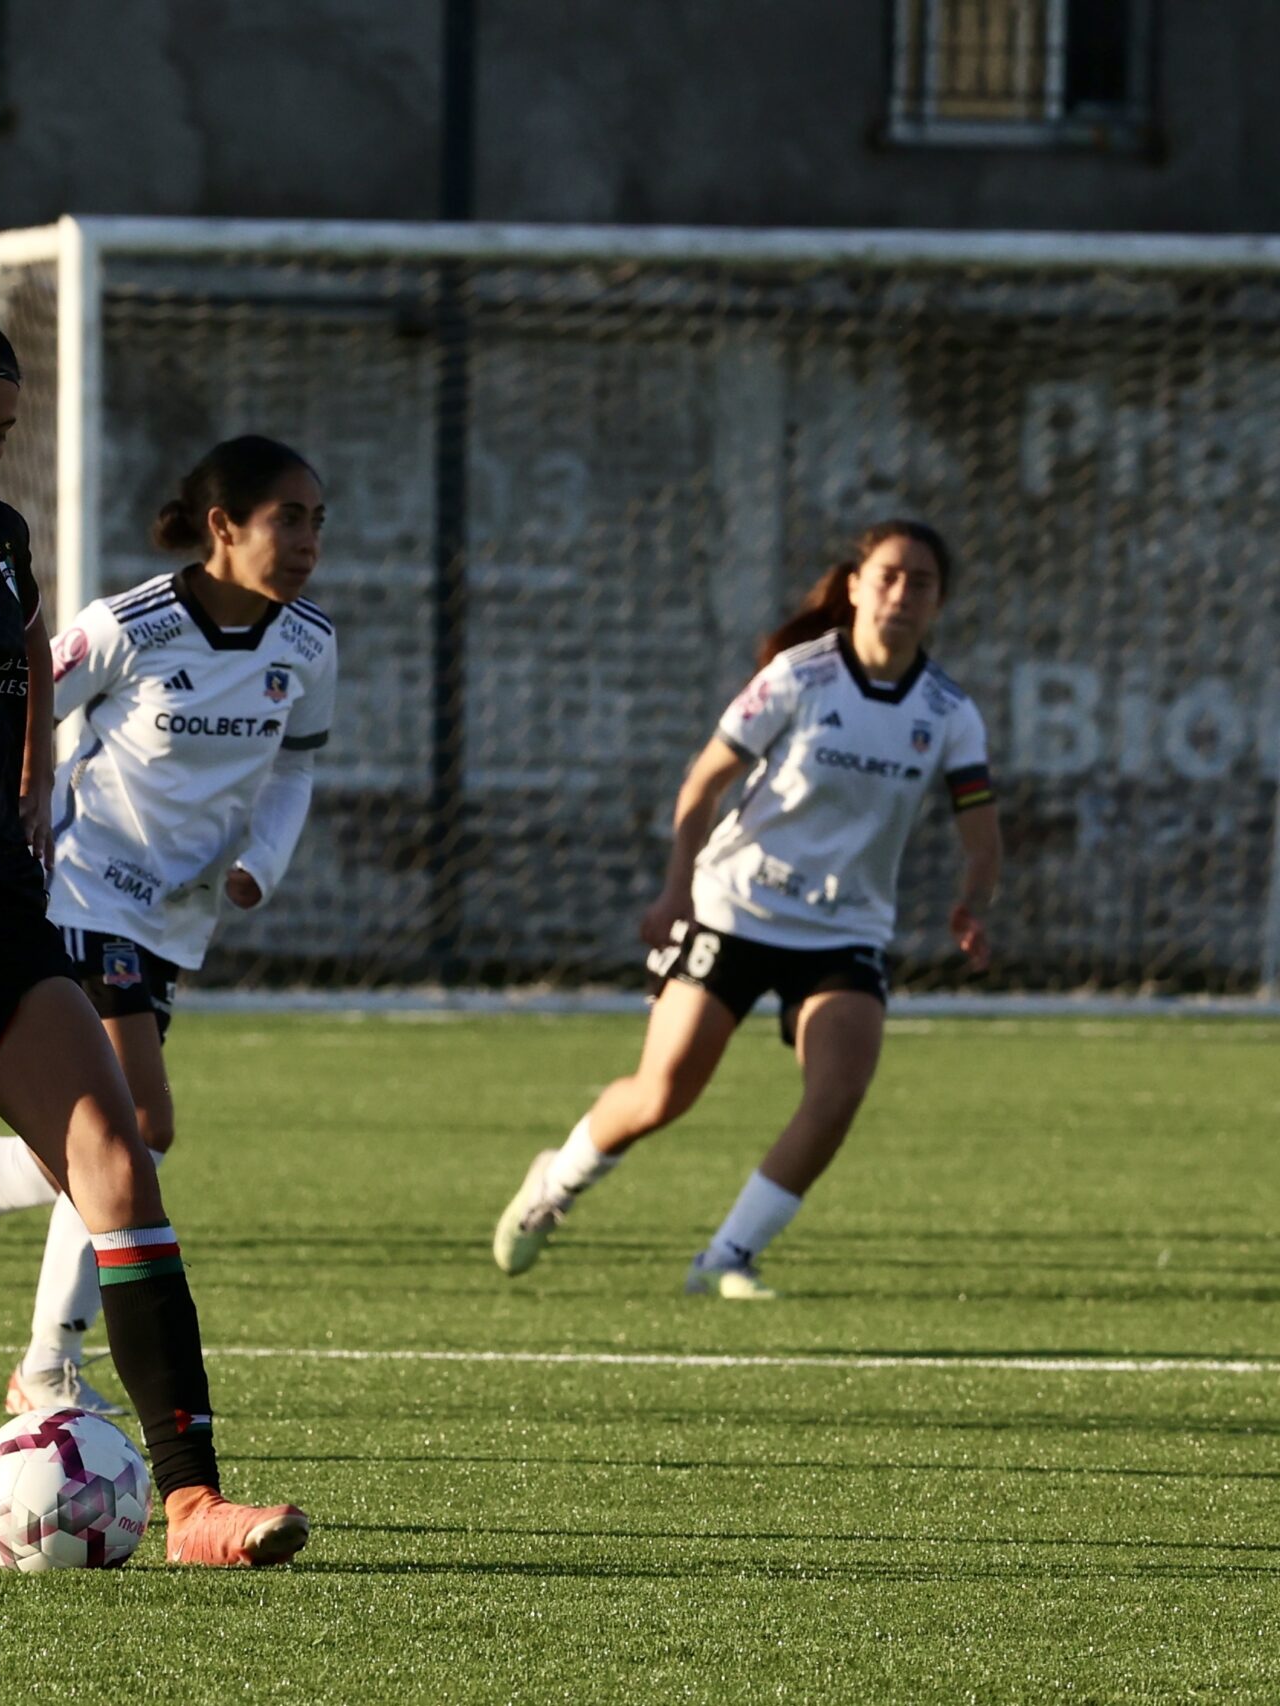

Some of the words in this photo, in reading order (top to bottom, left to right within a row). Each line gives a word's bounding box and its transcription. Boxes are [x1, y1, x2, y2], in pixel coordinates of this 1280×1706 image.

[126, 610, 182, 646] Pilsen
[152, 626, 183, 650] Sur
[279, 612, 324, 654] Pilsen
[155, 712, 258, 738] COOLBET
[815, 745, 902, 778] COOLBET
[103, 864, 154, 906] PUMA
